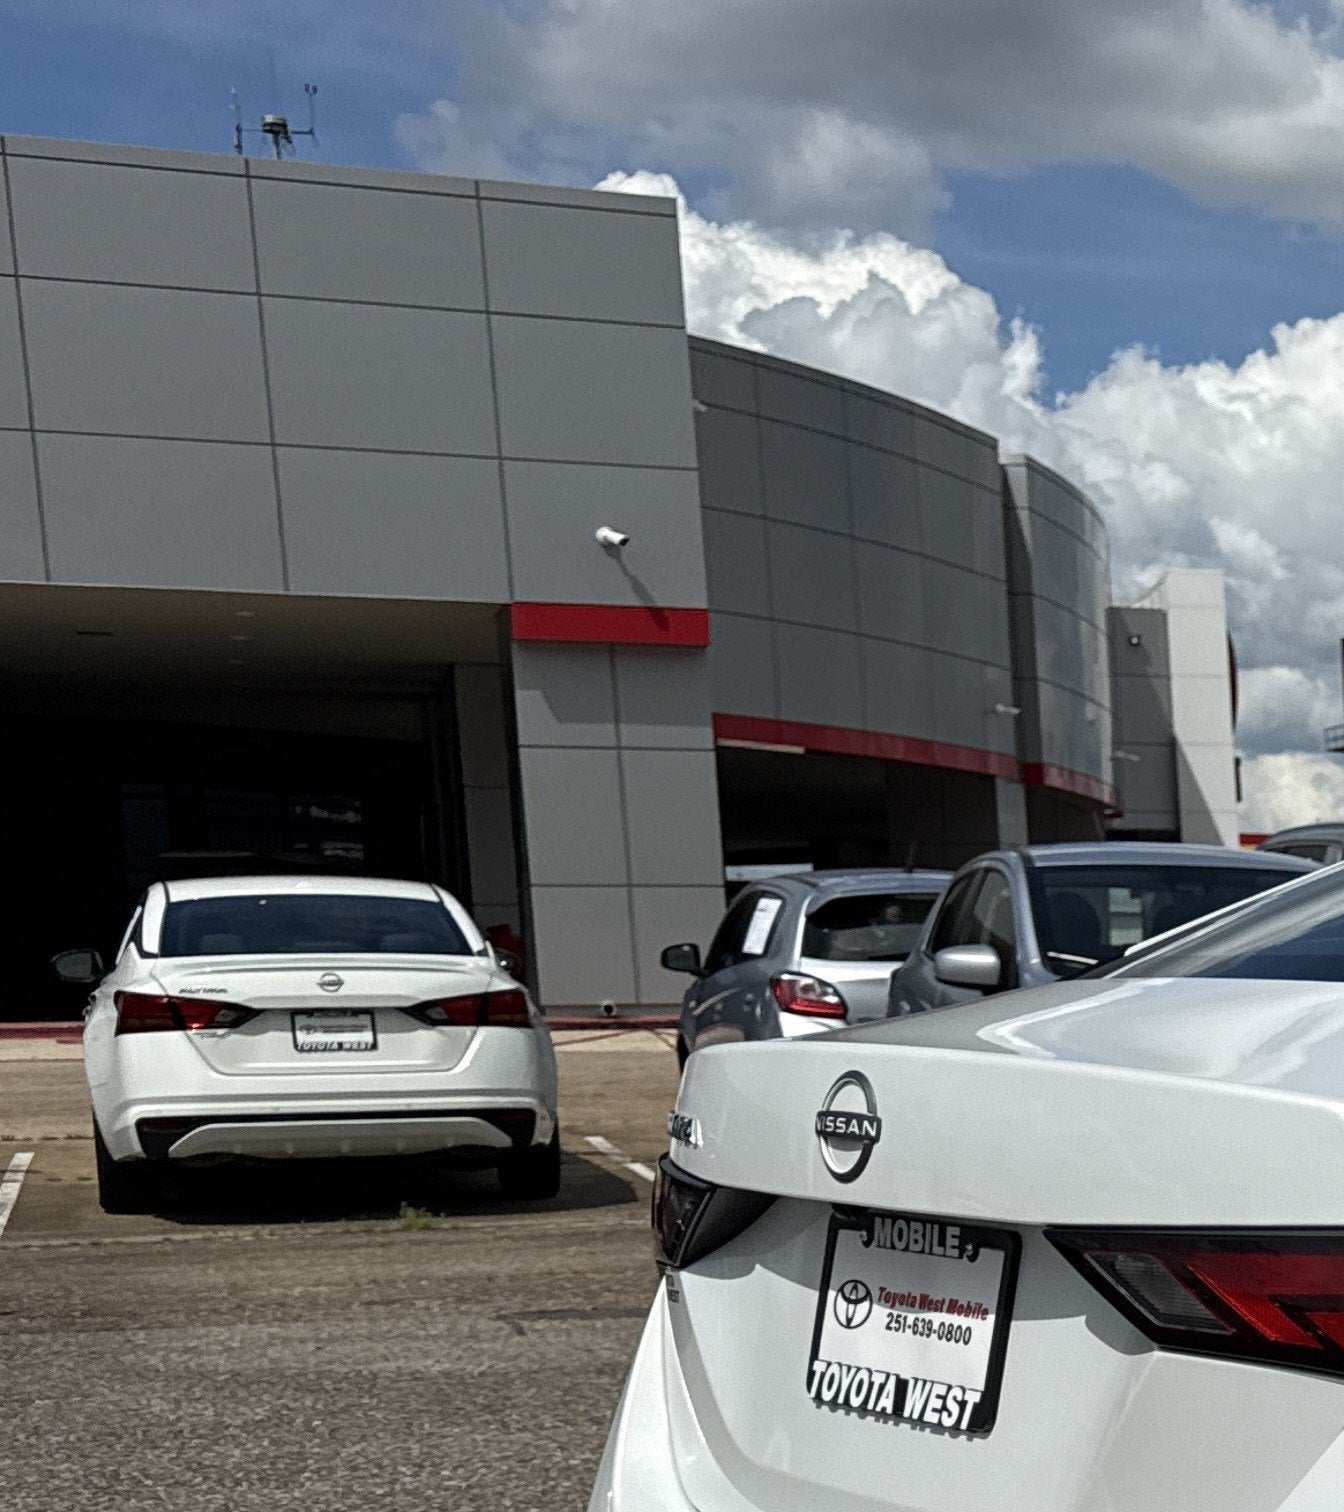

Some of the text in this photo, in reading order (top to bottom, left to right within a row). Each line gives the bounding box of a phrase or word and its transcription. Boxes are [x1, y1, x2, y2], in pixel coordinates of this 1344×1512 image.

[815, 1115, 878, 1138] NISSAN
[872, 1217, 961, 1258] MOBILE
[878, 1286, 989, 1321] Toyota West Mobile
[885, 1312, 972, 1346] 251-639-0800
[809, 1360, 982, 1430] TOYOTA WEST
